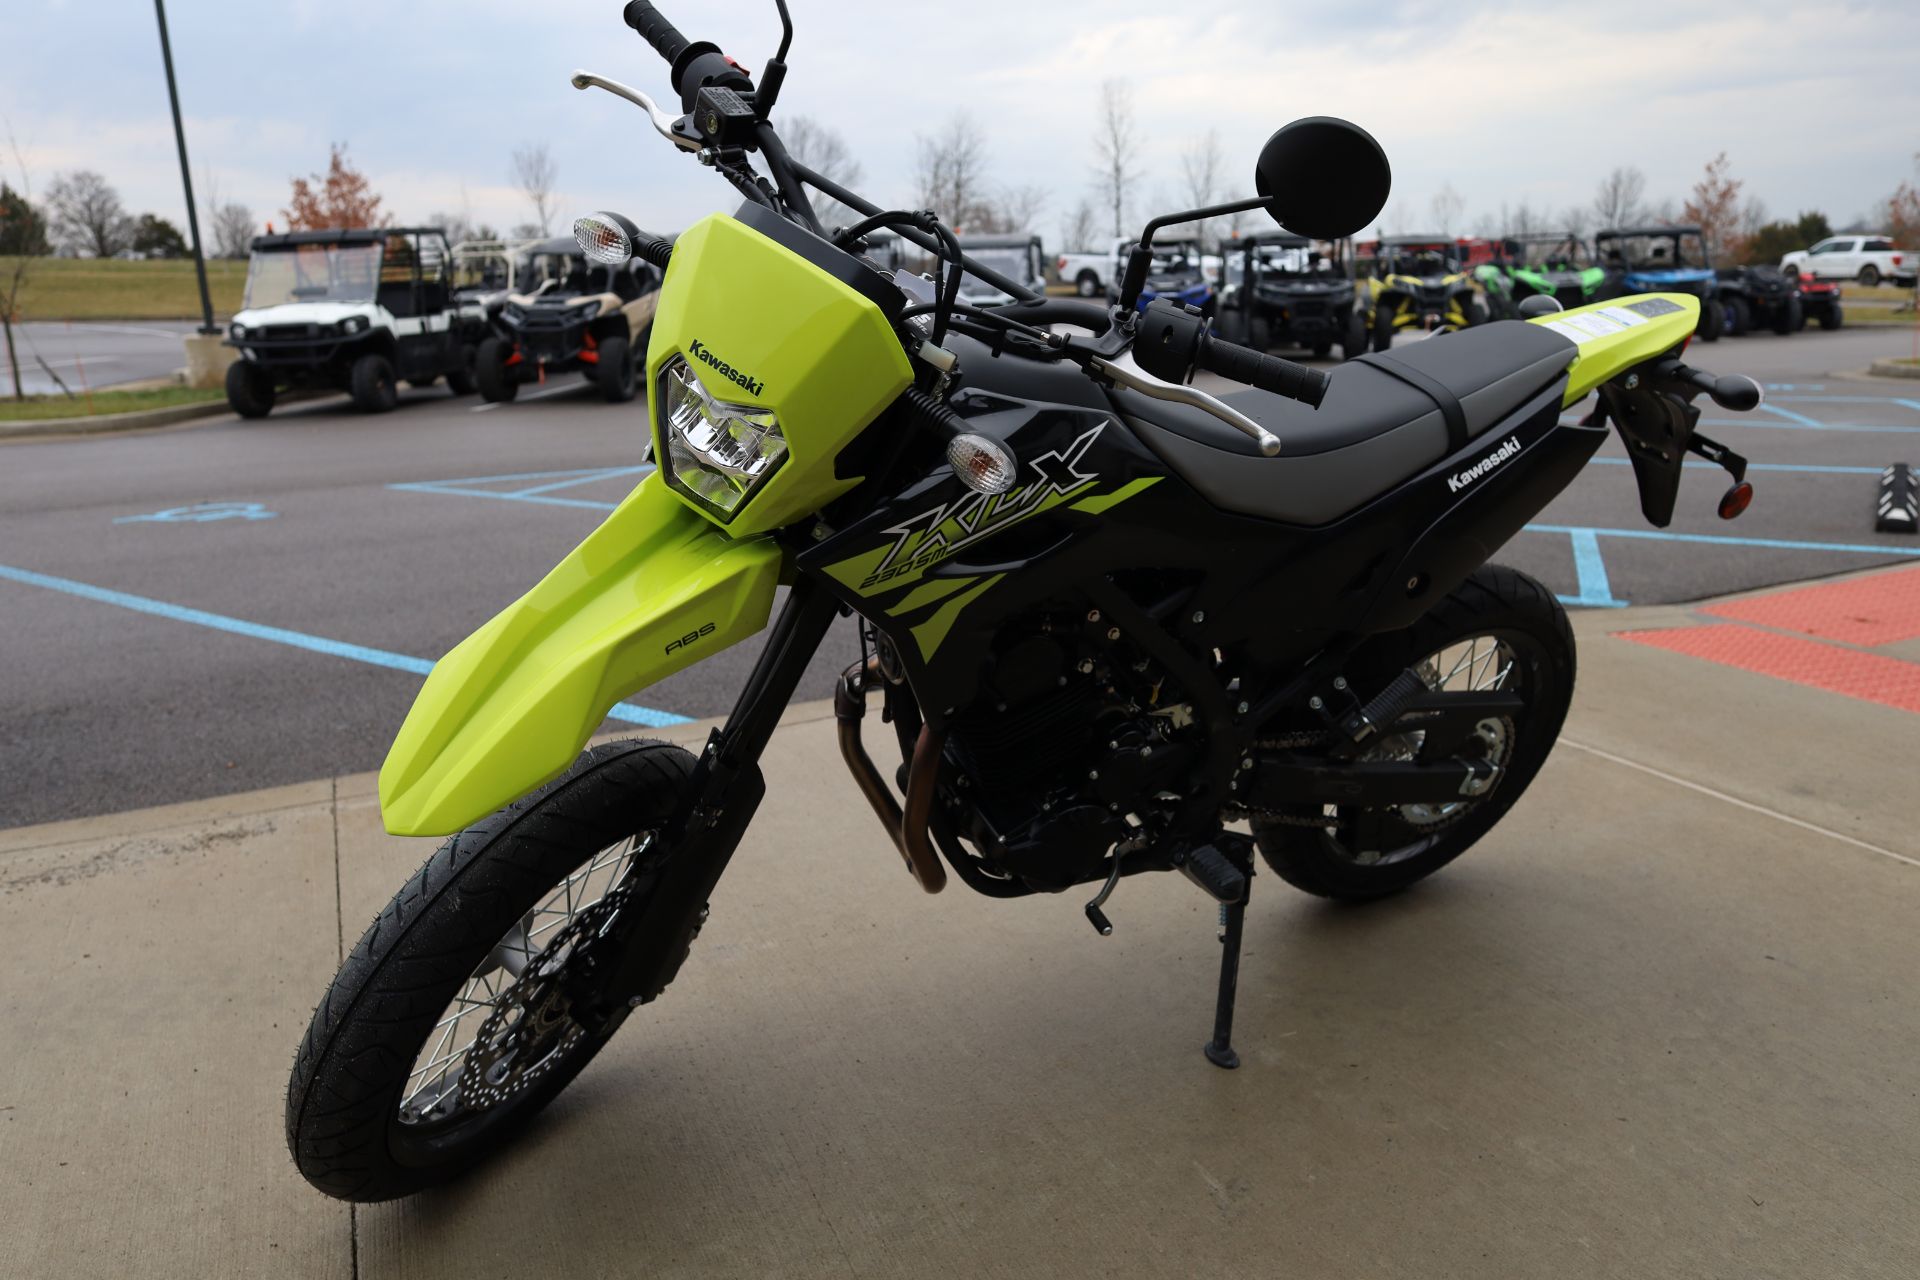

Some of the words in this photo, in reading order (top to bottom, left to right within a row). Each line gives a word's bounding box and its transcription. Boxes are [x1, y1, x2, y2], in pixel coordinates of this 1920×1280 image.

[688, 338, 765, 397] Kawasaki
[1447, 435, 1522, 493] Kawasaki
[665, 622, 716, 656] ABS
